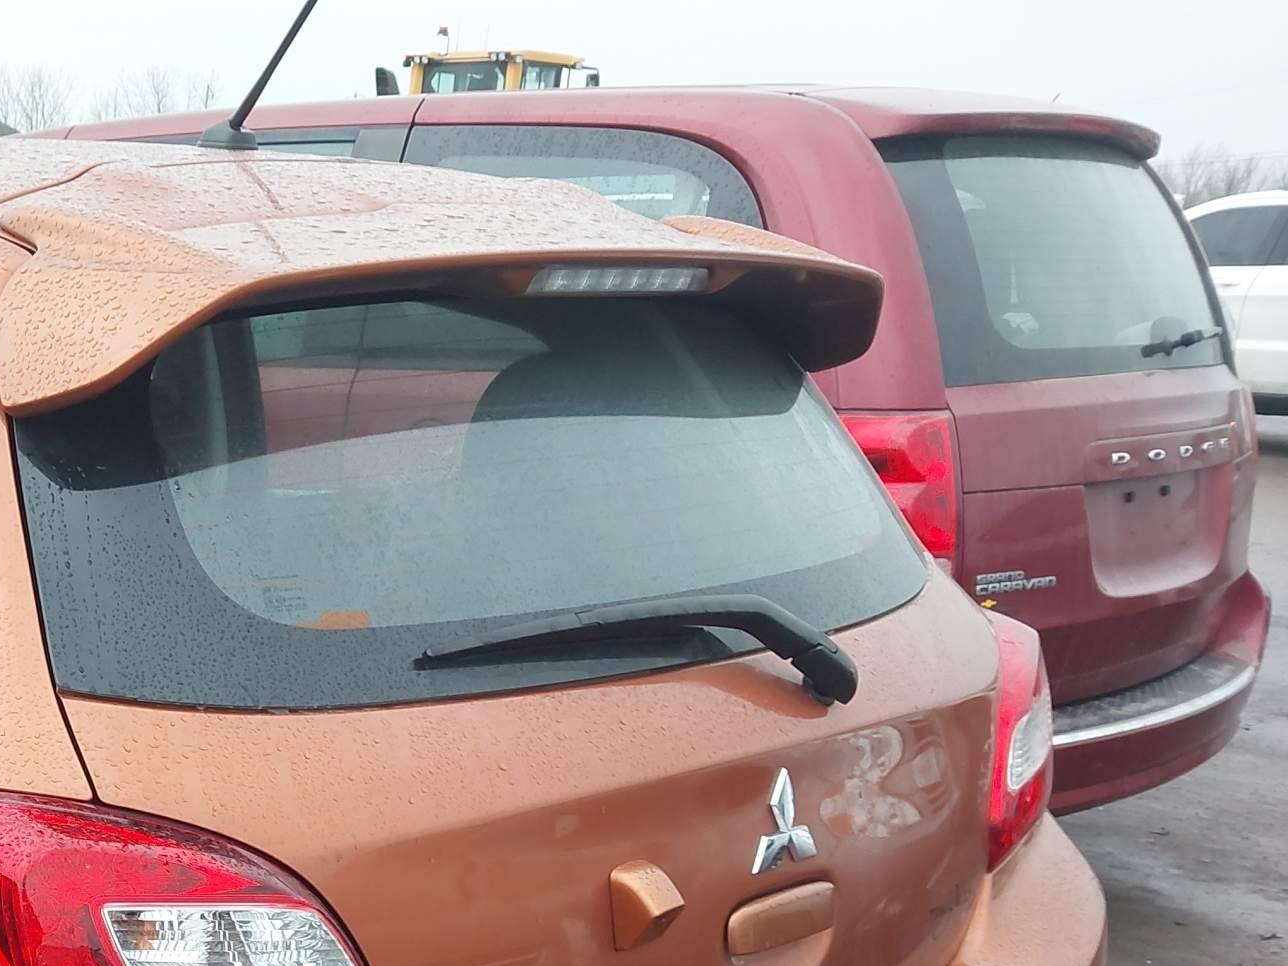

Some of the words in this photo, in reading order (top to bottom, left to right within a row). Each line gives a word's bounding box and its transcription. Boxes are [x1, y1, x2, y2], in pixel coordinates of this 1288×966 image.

[1111, 437, 1229, 465] DODGE
[975, 575, 1057, 596] CARAVAN
[976, 570, 1025, 585] GRAND
